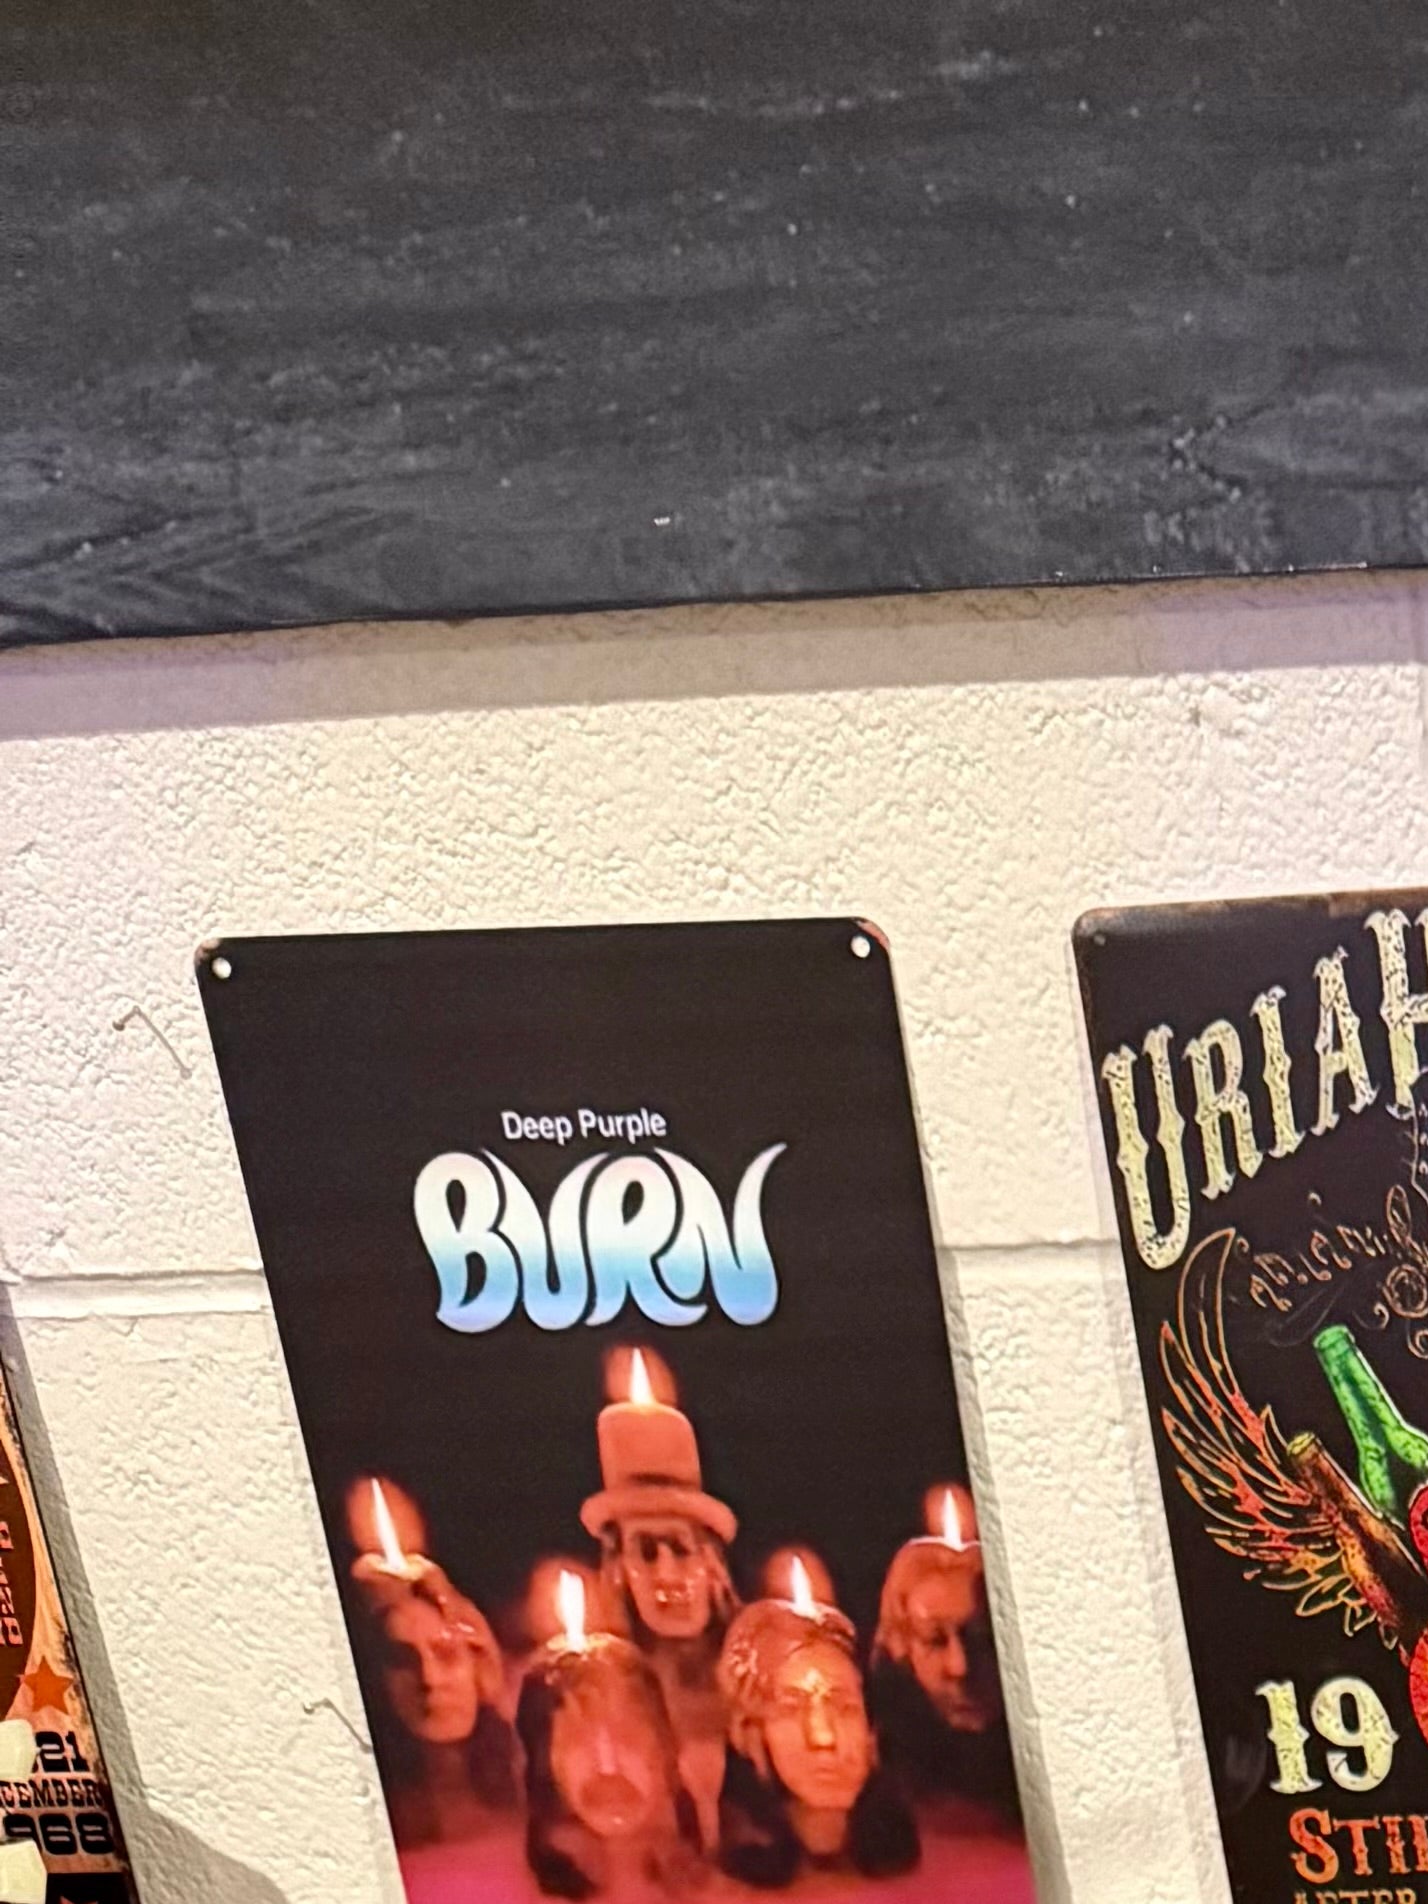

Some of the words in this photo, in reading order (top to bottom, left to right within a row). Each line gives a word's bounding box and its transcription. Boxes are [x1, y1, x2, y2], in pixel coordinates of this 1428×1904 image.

[500, 1108, 573, 1144] Deep
[577, 1106, 668, 1143] Purple
[411, 1141, 789, 1333] BURN
[1253, 1674, 1401, 1797] 19
[0, 1777, 103, 1809] CEMBER
[0, 1811, 115, 1857] 968
